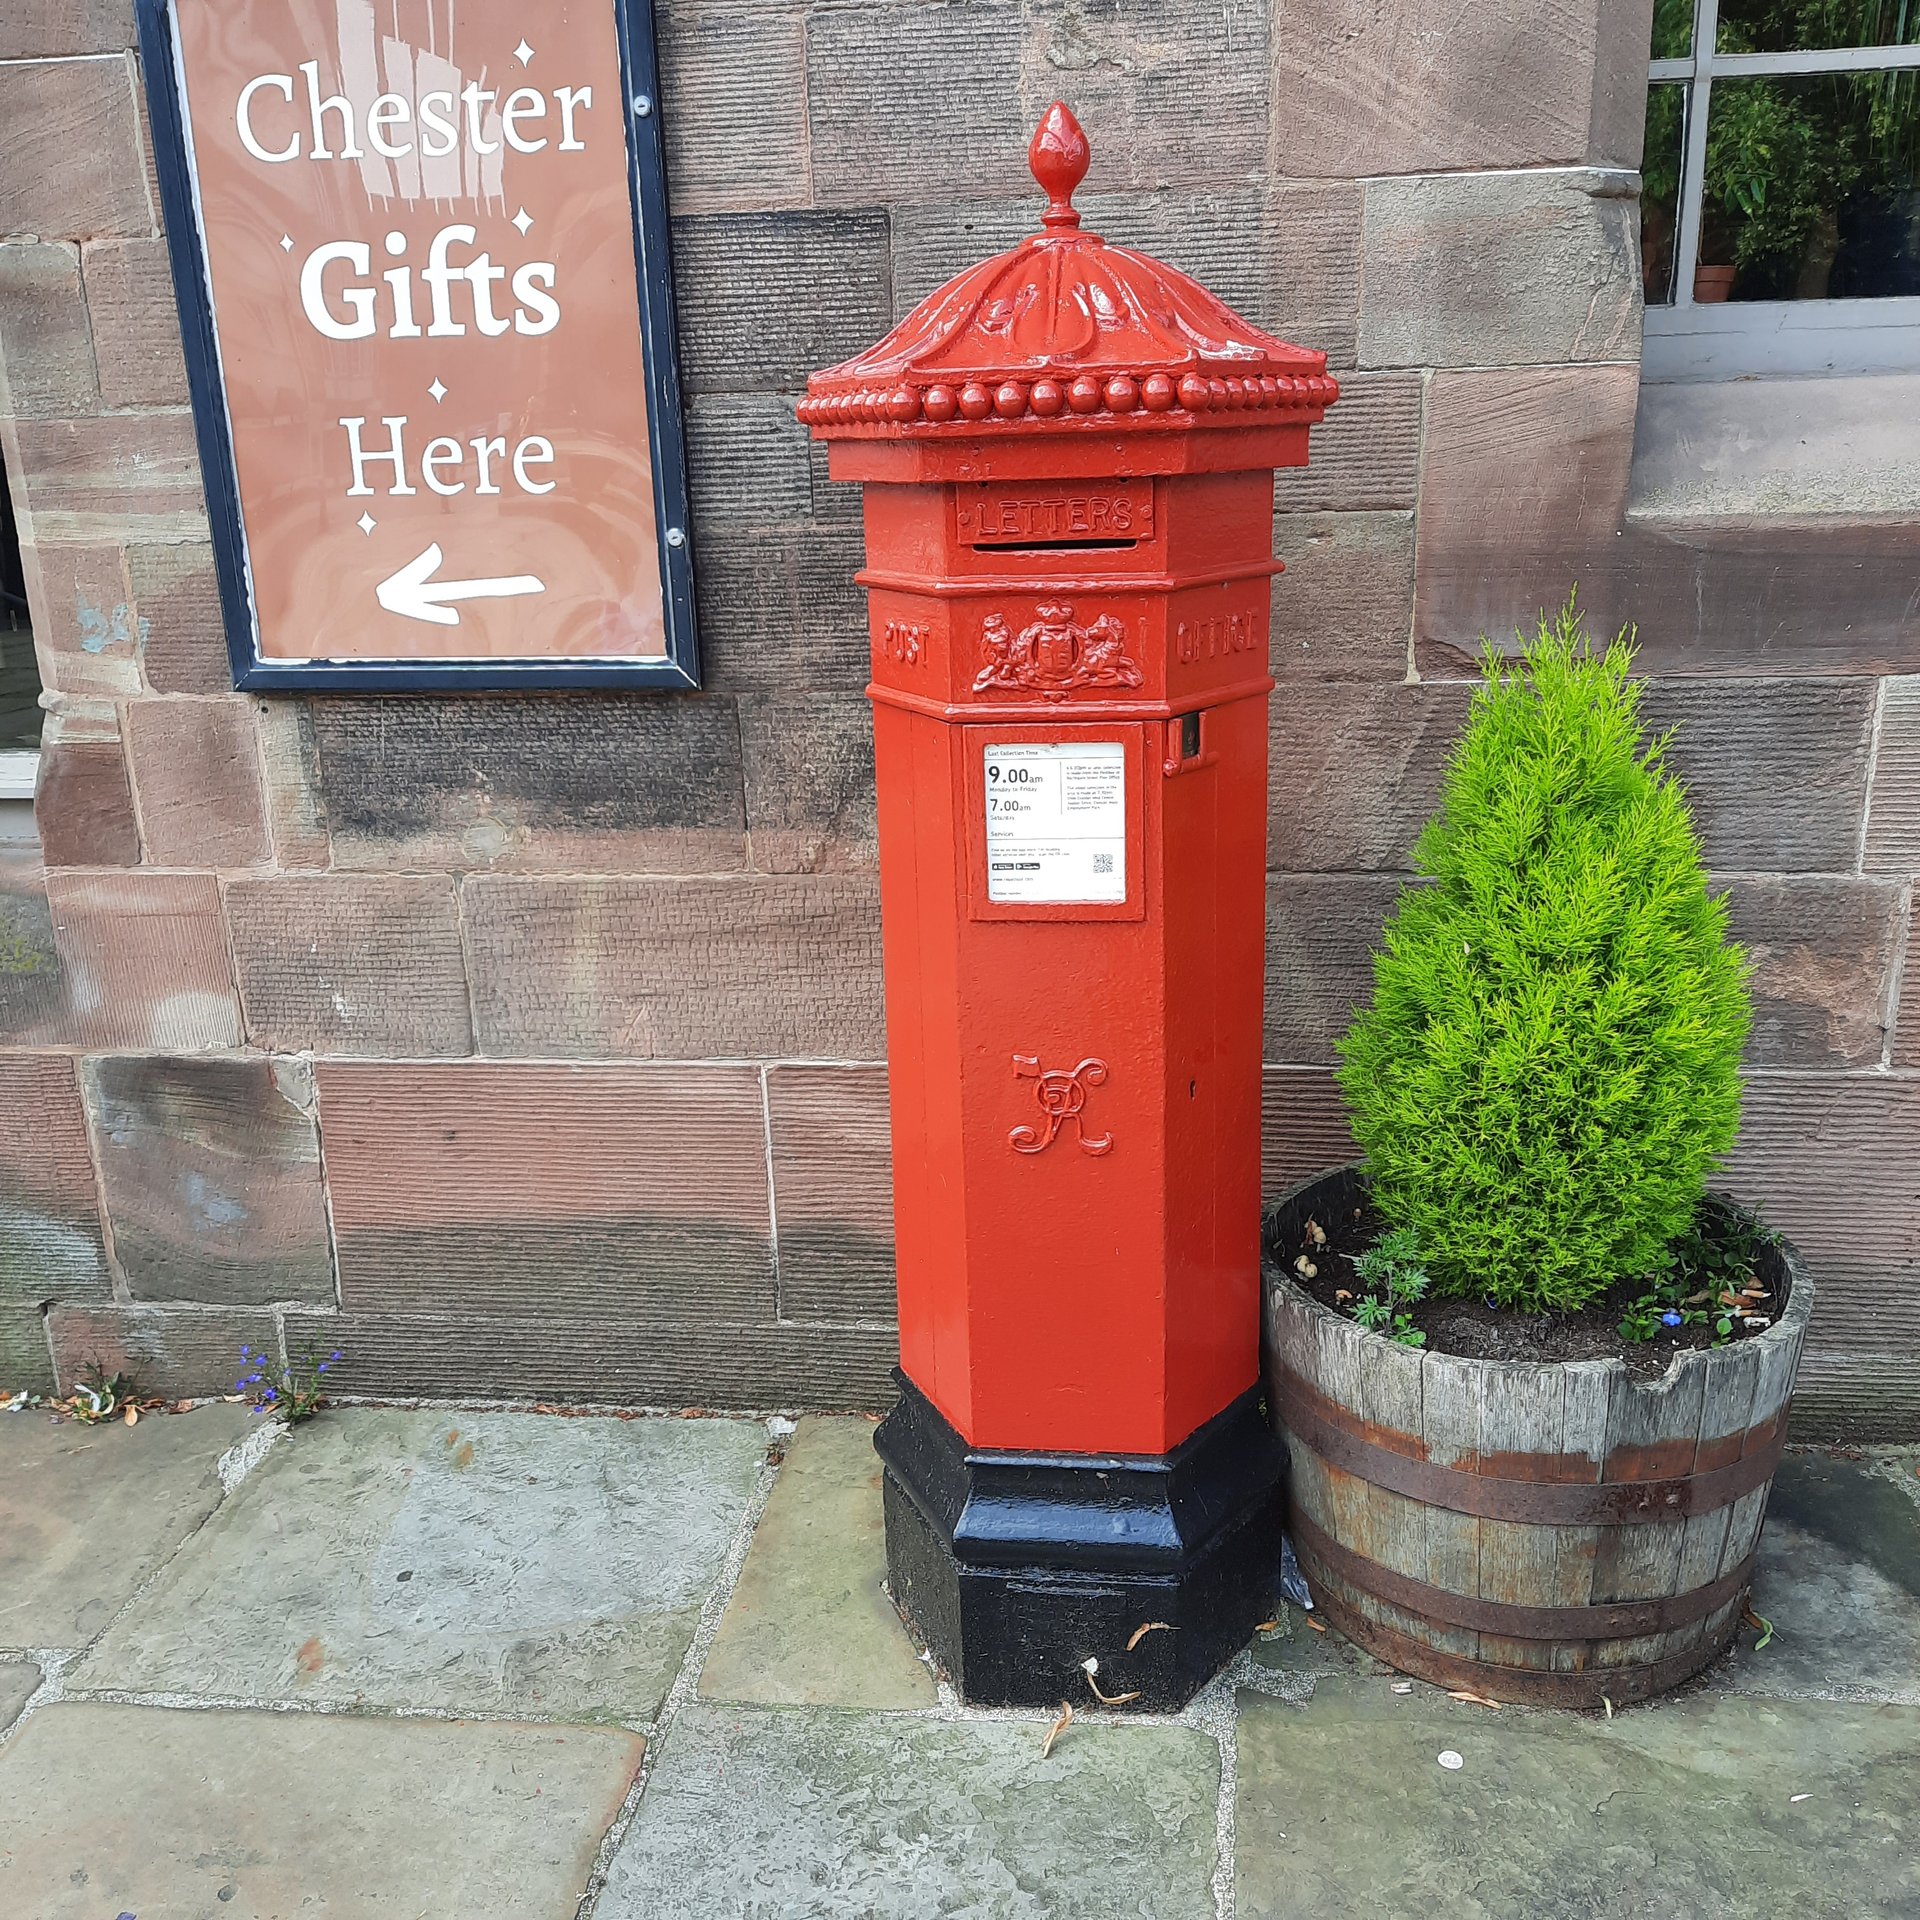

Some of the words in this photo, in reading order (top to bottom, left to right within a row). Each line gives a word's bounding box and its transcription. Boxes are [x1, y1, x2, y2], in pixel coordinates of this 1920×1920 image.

[235, 60, 592, 163] Chester
[299, 224, 562, 340] Gifts
[338, 415, 558, 498] Here
[976, 497, 1133, 536] LETTERS
[883, 617, 930, 668] POST
[1175, 610, 1257, 666] OFFICE
